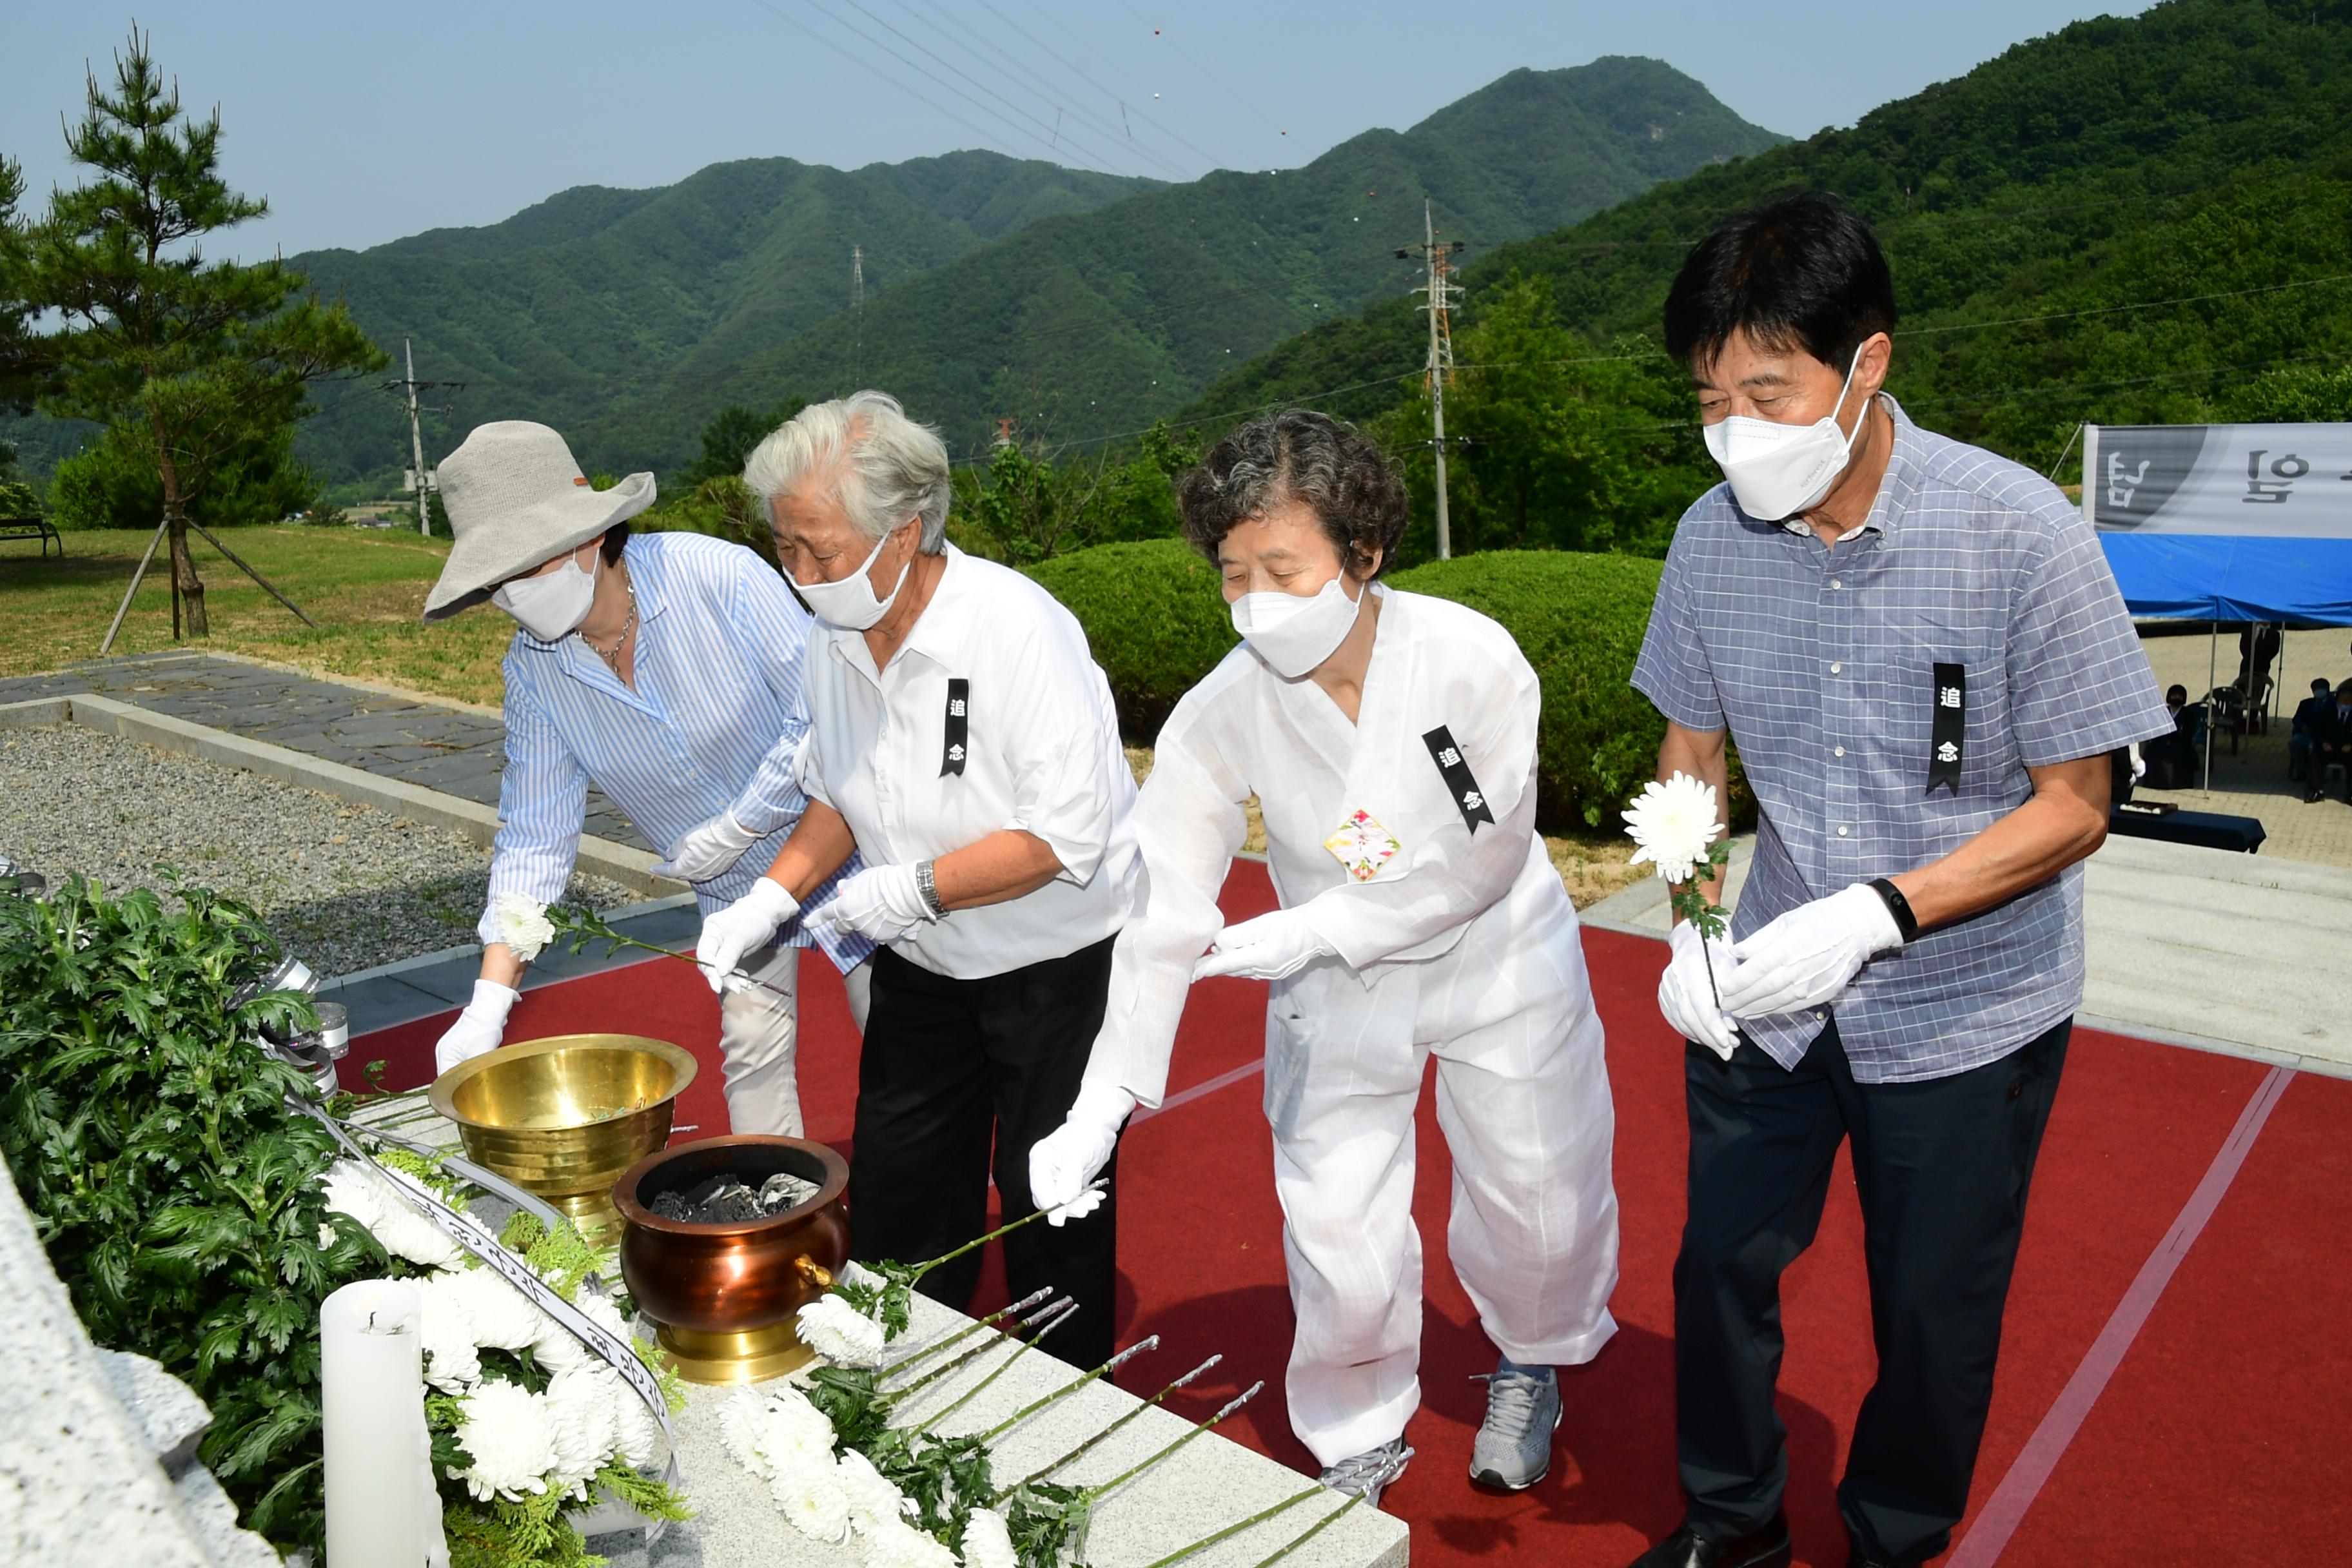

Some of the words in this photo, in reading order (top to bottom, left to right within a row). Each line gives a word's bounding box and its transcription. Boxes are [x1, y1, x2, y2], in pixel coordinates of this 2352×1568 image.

[948, 698, 966, 761] 追念
[1937, 687, 1961, 762] 追念
[1438, 747, 1484, 811] 追念
[587, 1326, 665, 1418] 최문순
